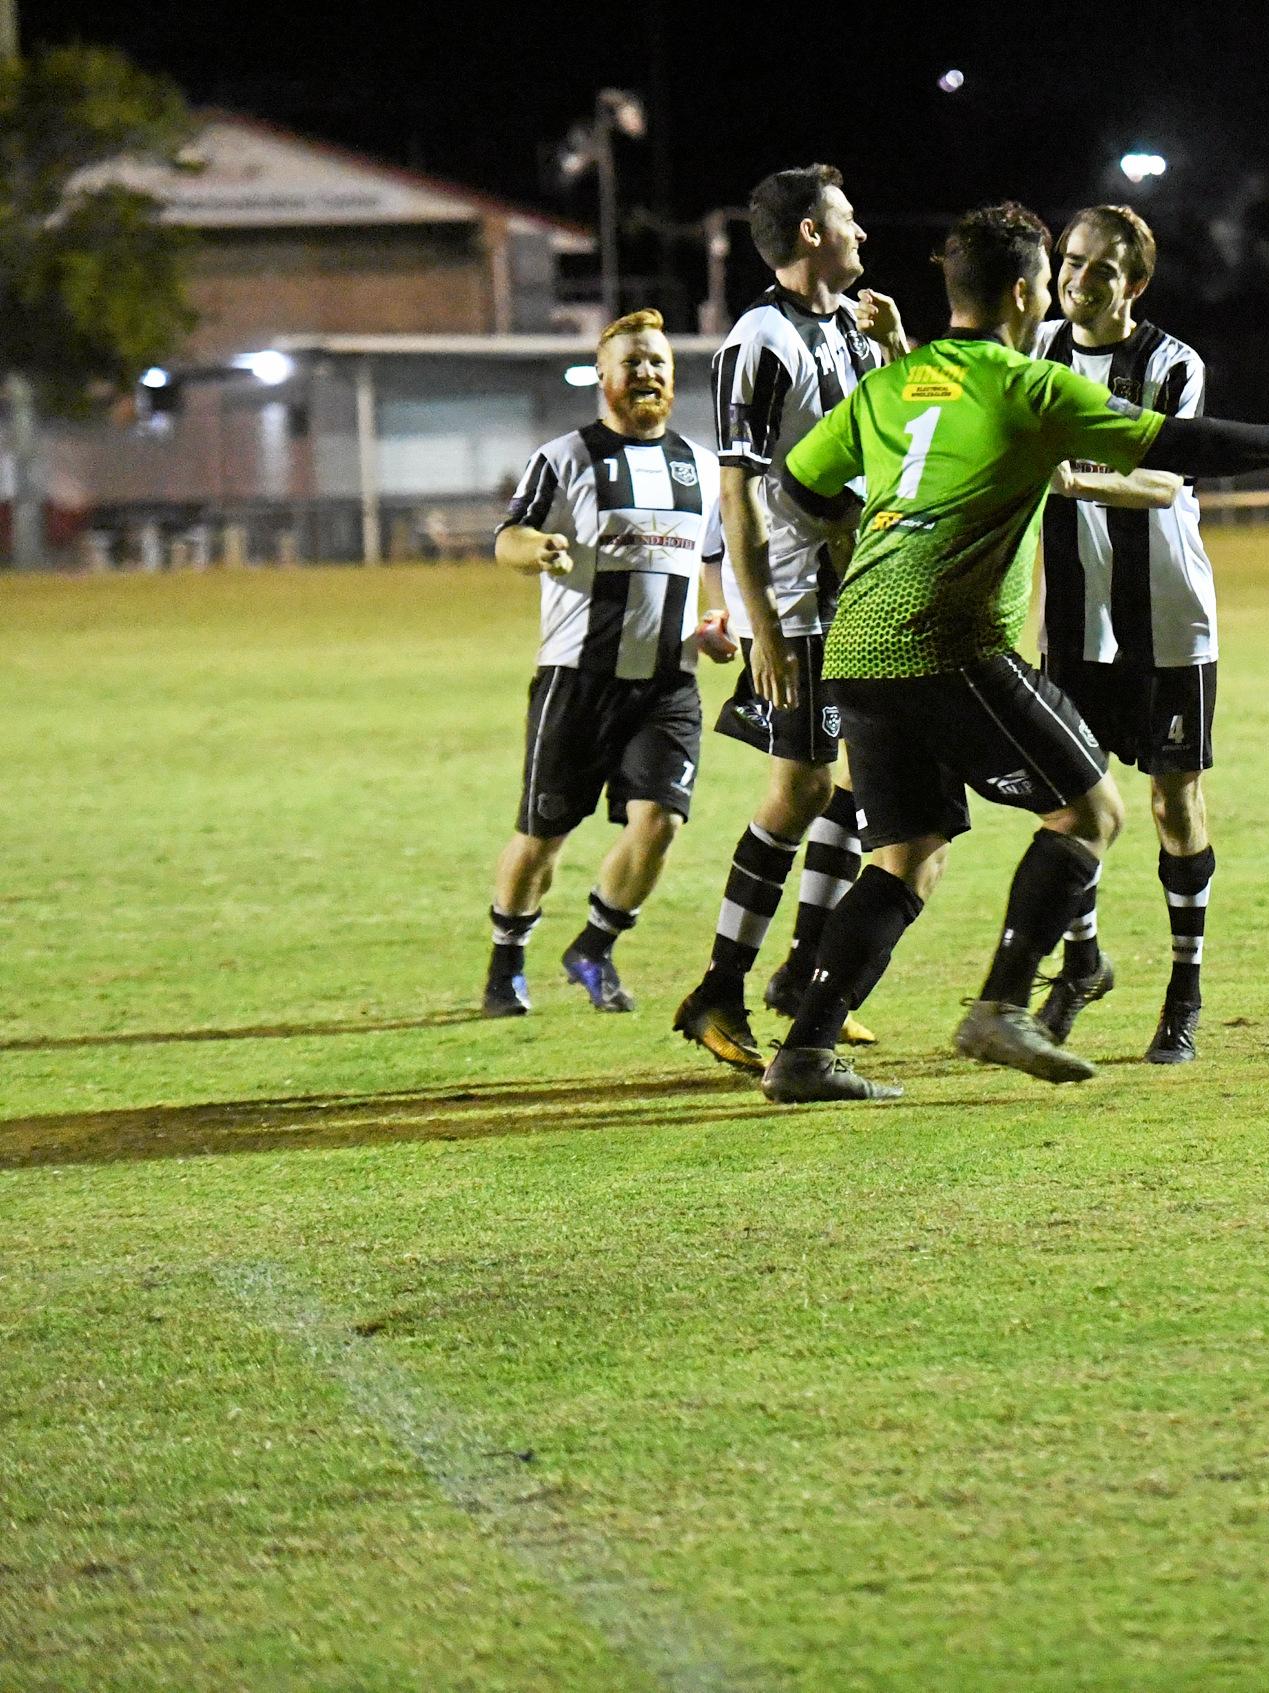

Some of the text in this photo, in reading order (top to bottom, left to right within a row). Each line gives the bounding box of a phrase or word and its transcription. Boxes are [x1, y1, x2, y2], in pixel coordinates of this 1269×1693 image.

[895, 406, 942, 499] 1
[1167, 715, 1184, 744] 4
[681, 760, 695, 787] 7
